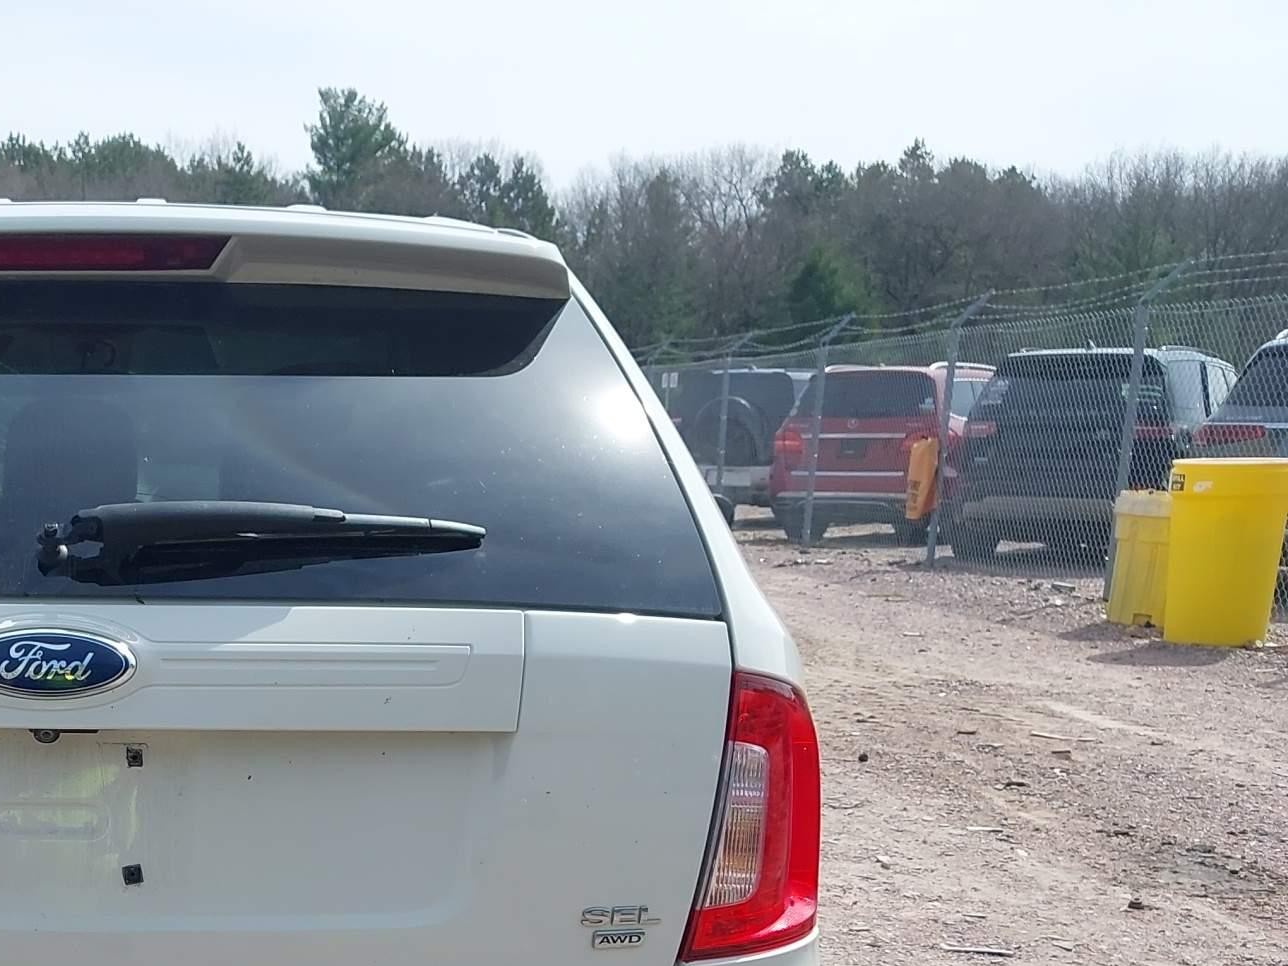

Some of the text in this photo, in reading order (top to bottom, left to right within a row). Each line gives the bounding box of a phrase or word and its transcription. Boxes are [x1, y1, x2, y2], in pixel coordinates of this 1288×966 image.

[0, 640, 95, 681] Ford
[580, 905, 661, 927] SEL
[598, 934, 642, 945] AWD
